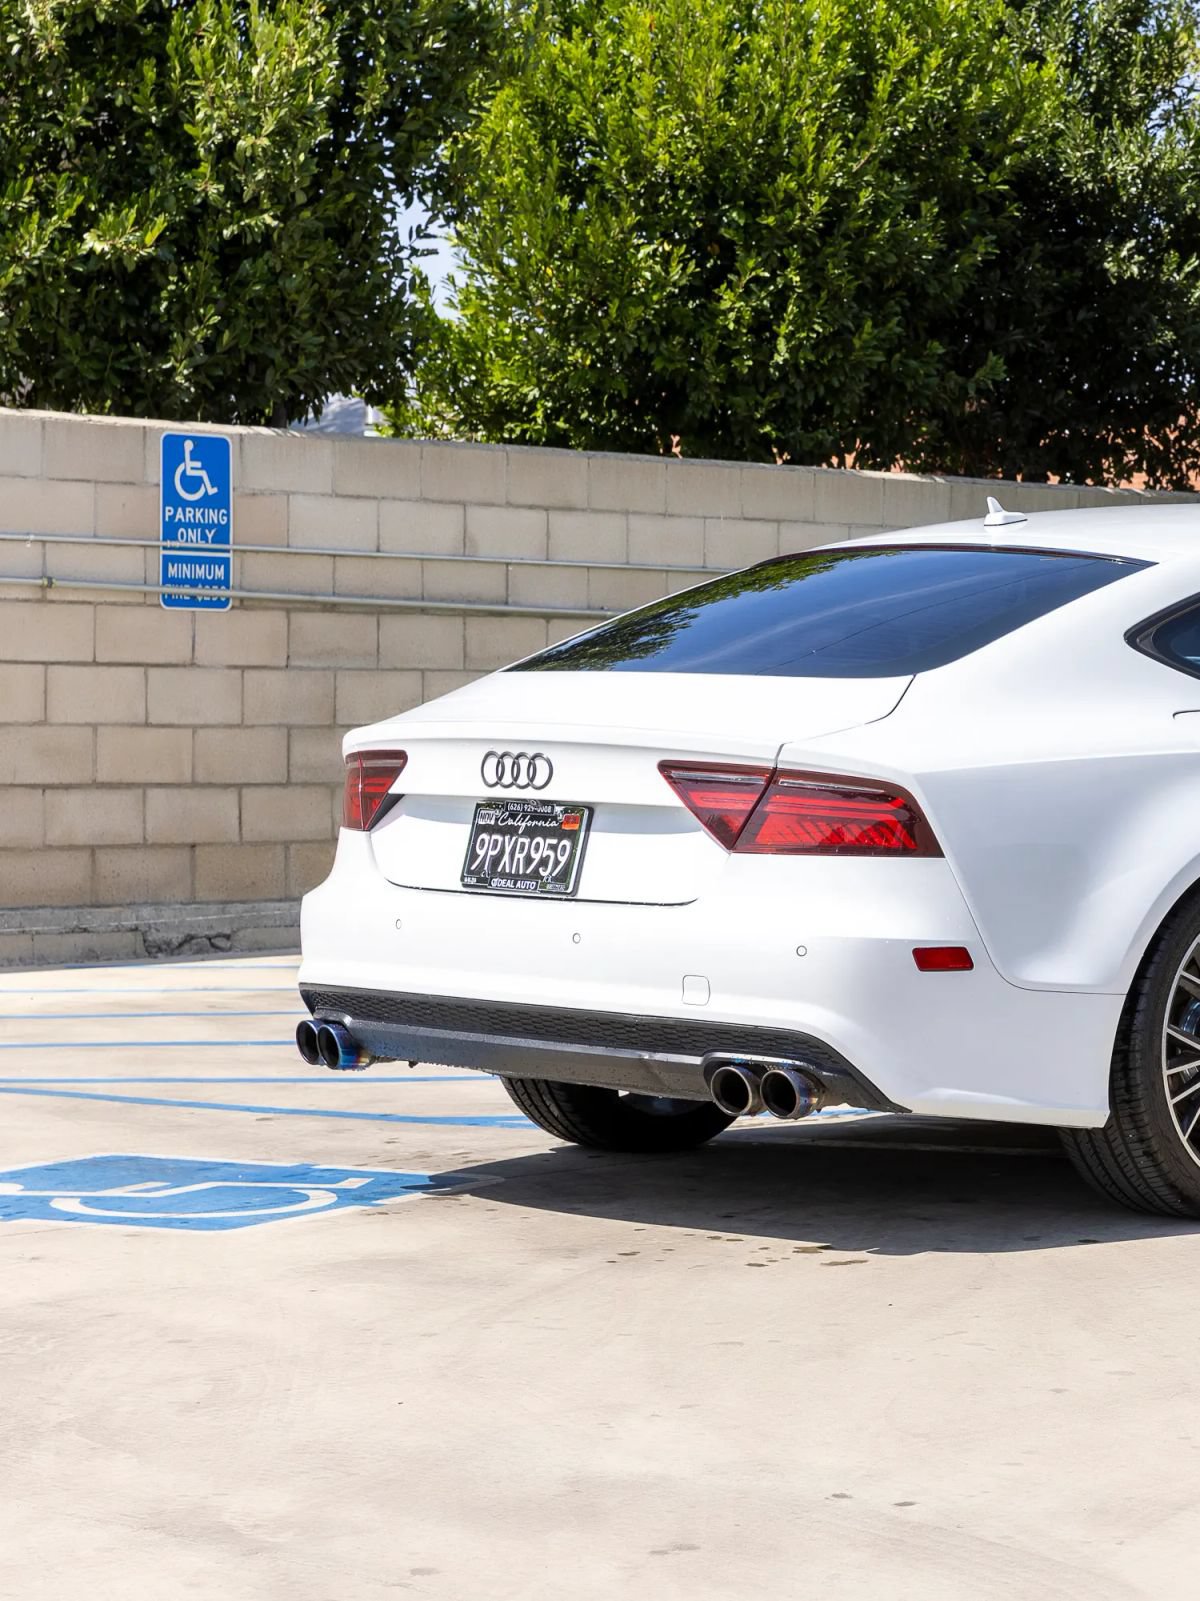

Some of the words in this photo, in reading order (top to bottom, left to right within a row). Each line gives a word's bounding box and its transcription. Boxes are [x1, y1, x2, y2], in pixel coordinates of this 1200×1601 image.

[164, 506, 228, 525] PARKING
[177, 528, 217, 544] ONLY
[168, 562, 225, 581] MINIMUM
[498, 812, 560, 834] California
[470, 833, 571, 877] 9PXR959
[515, 880, 537, 890] AUTO
